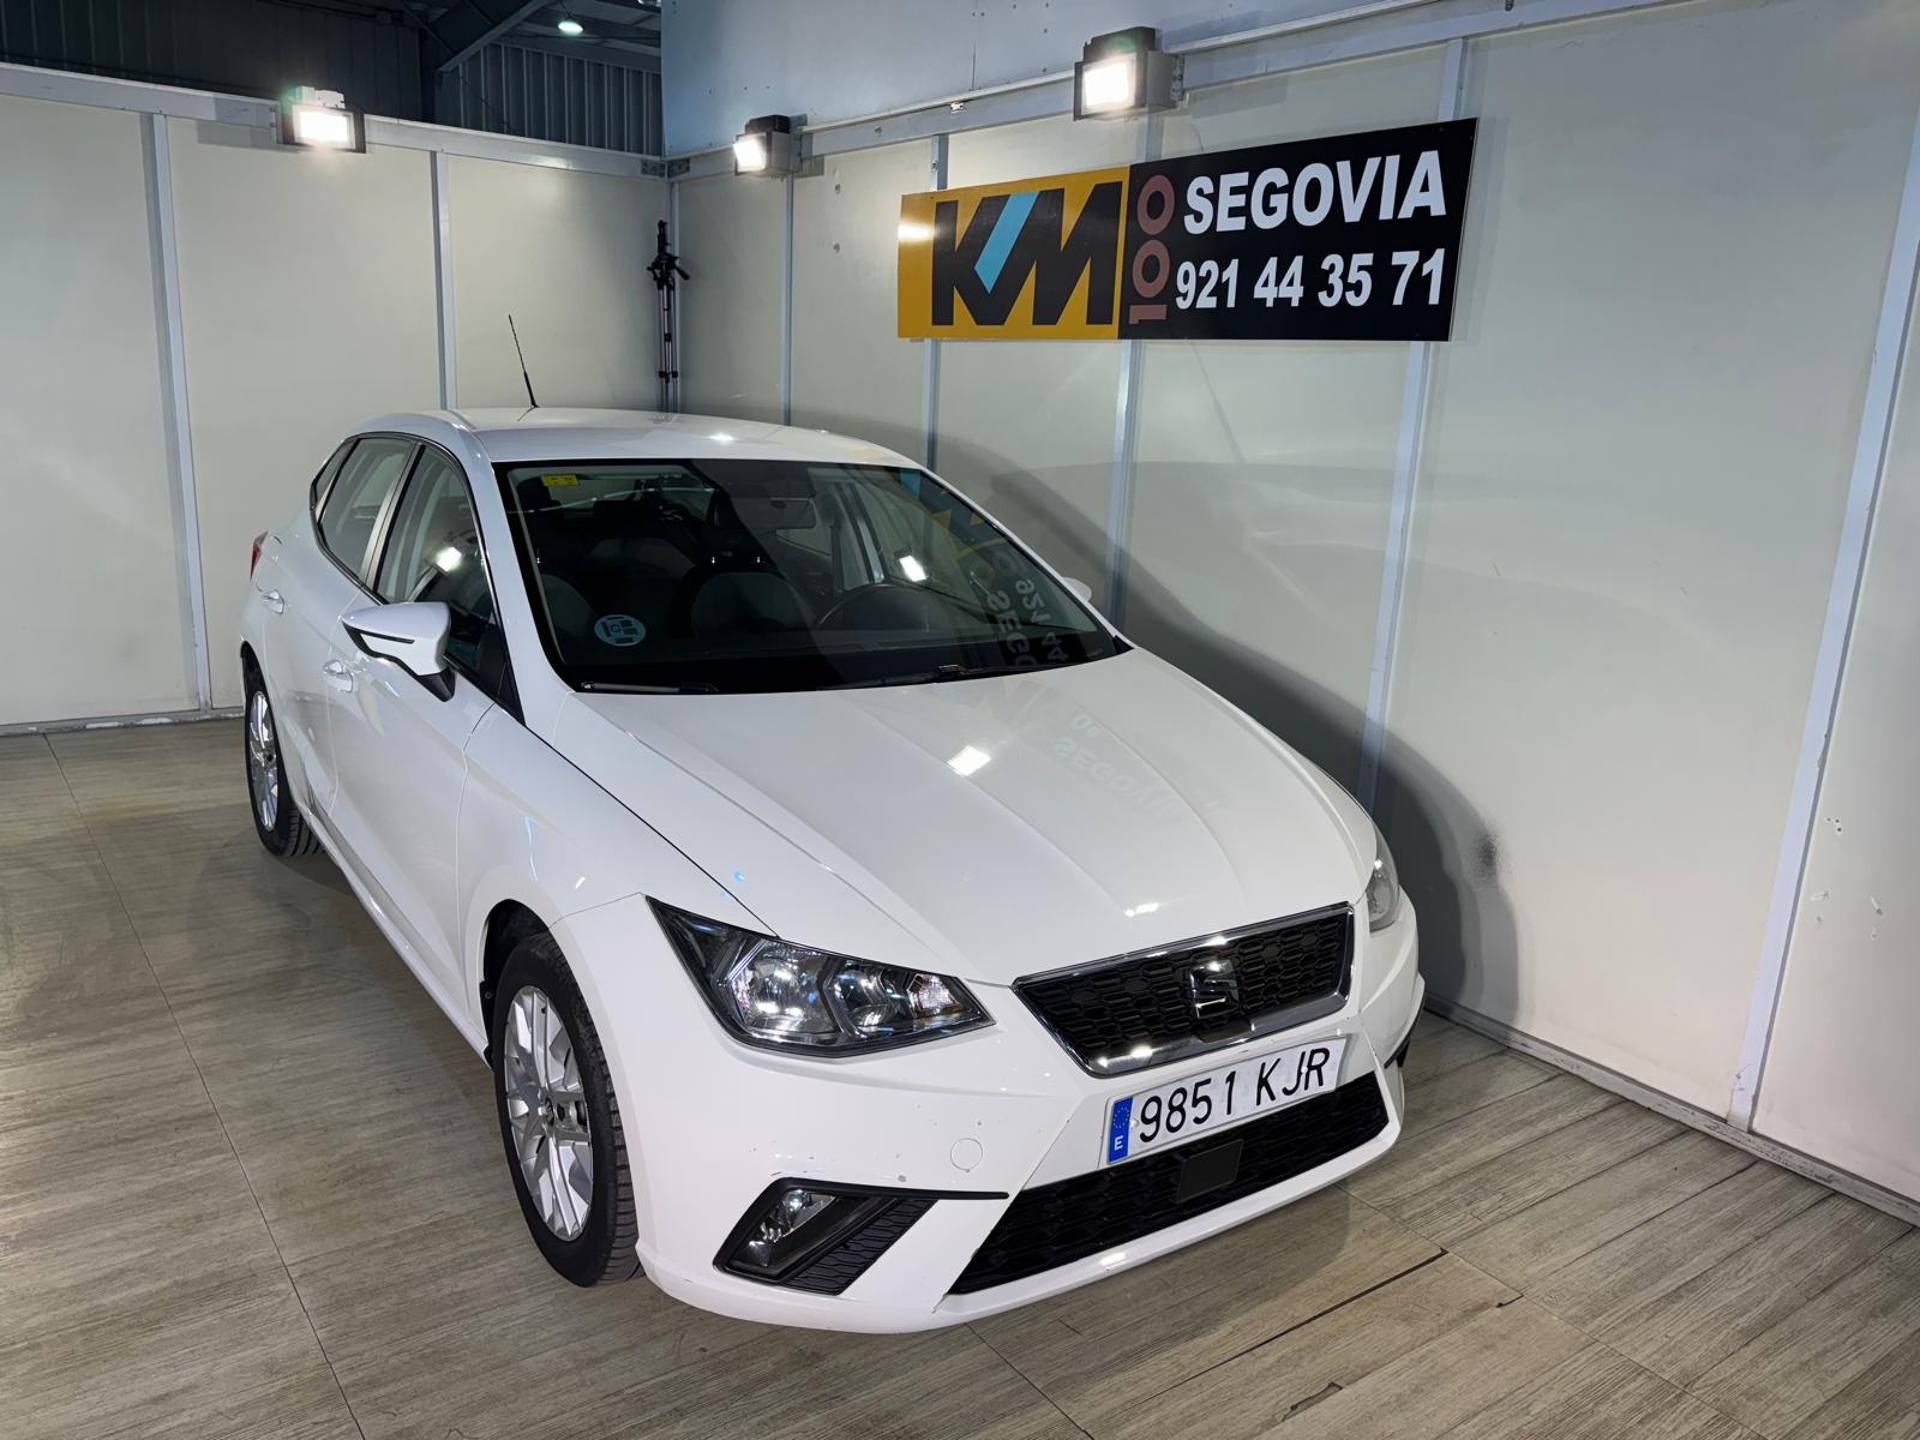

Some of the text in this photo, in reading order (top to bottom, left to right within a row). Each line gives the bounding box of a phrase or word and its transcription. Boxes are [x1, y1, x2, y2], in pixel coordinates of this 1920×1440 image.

[1184, 151, 1447, 235] SEGOVIA
[932, 182, 1123, 326] KM
[1130, 175, 1175, 325] 100
[1176, 248, 1445, 309] 921 44 35 71
[1139, 1047, 1331, 1143] 9851 KJR
[1114, 1135, 1124, 1151] E
